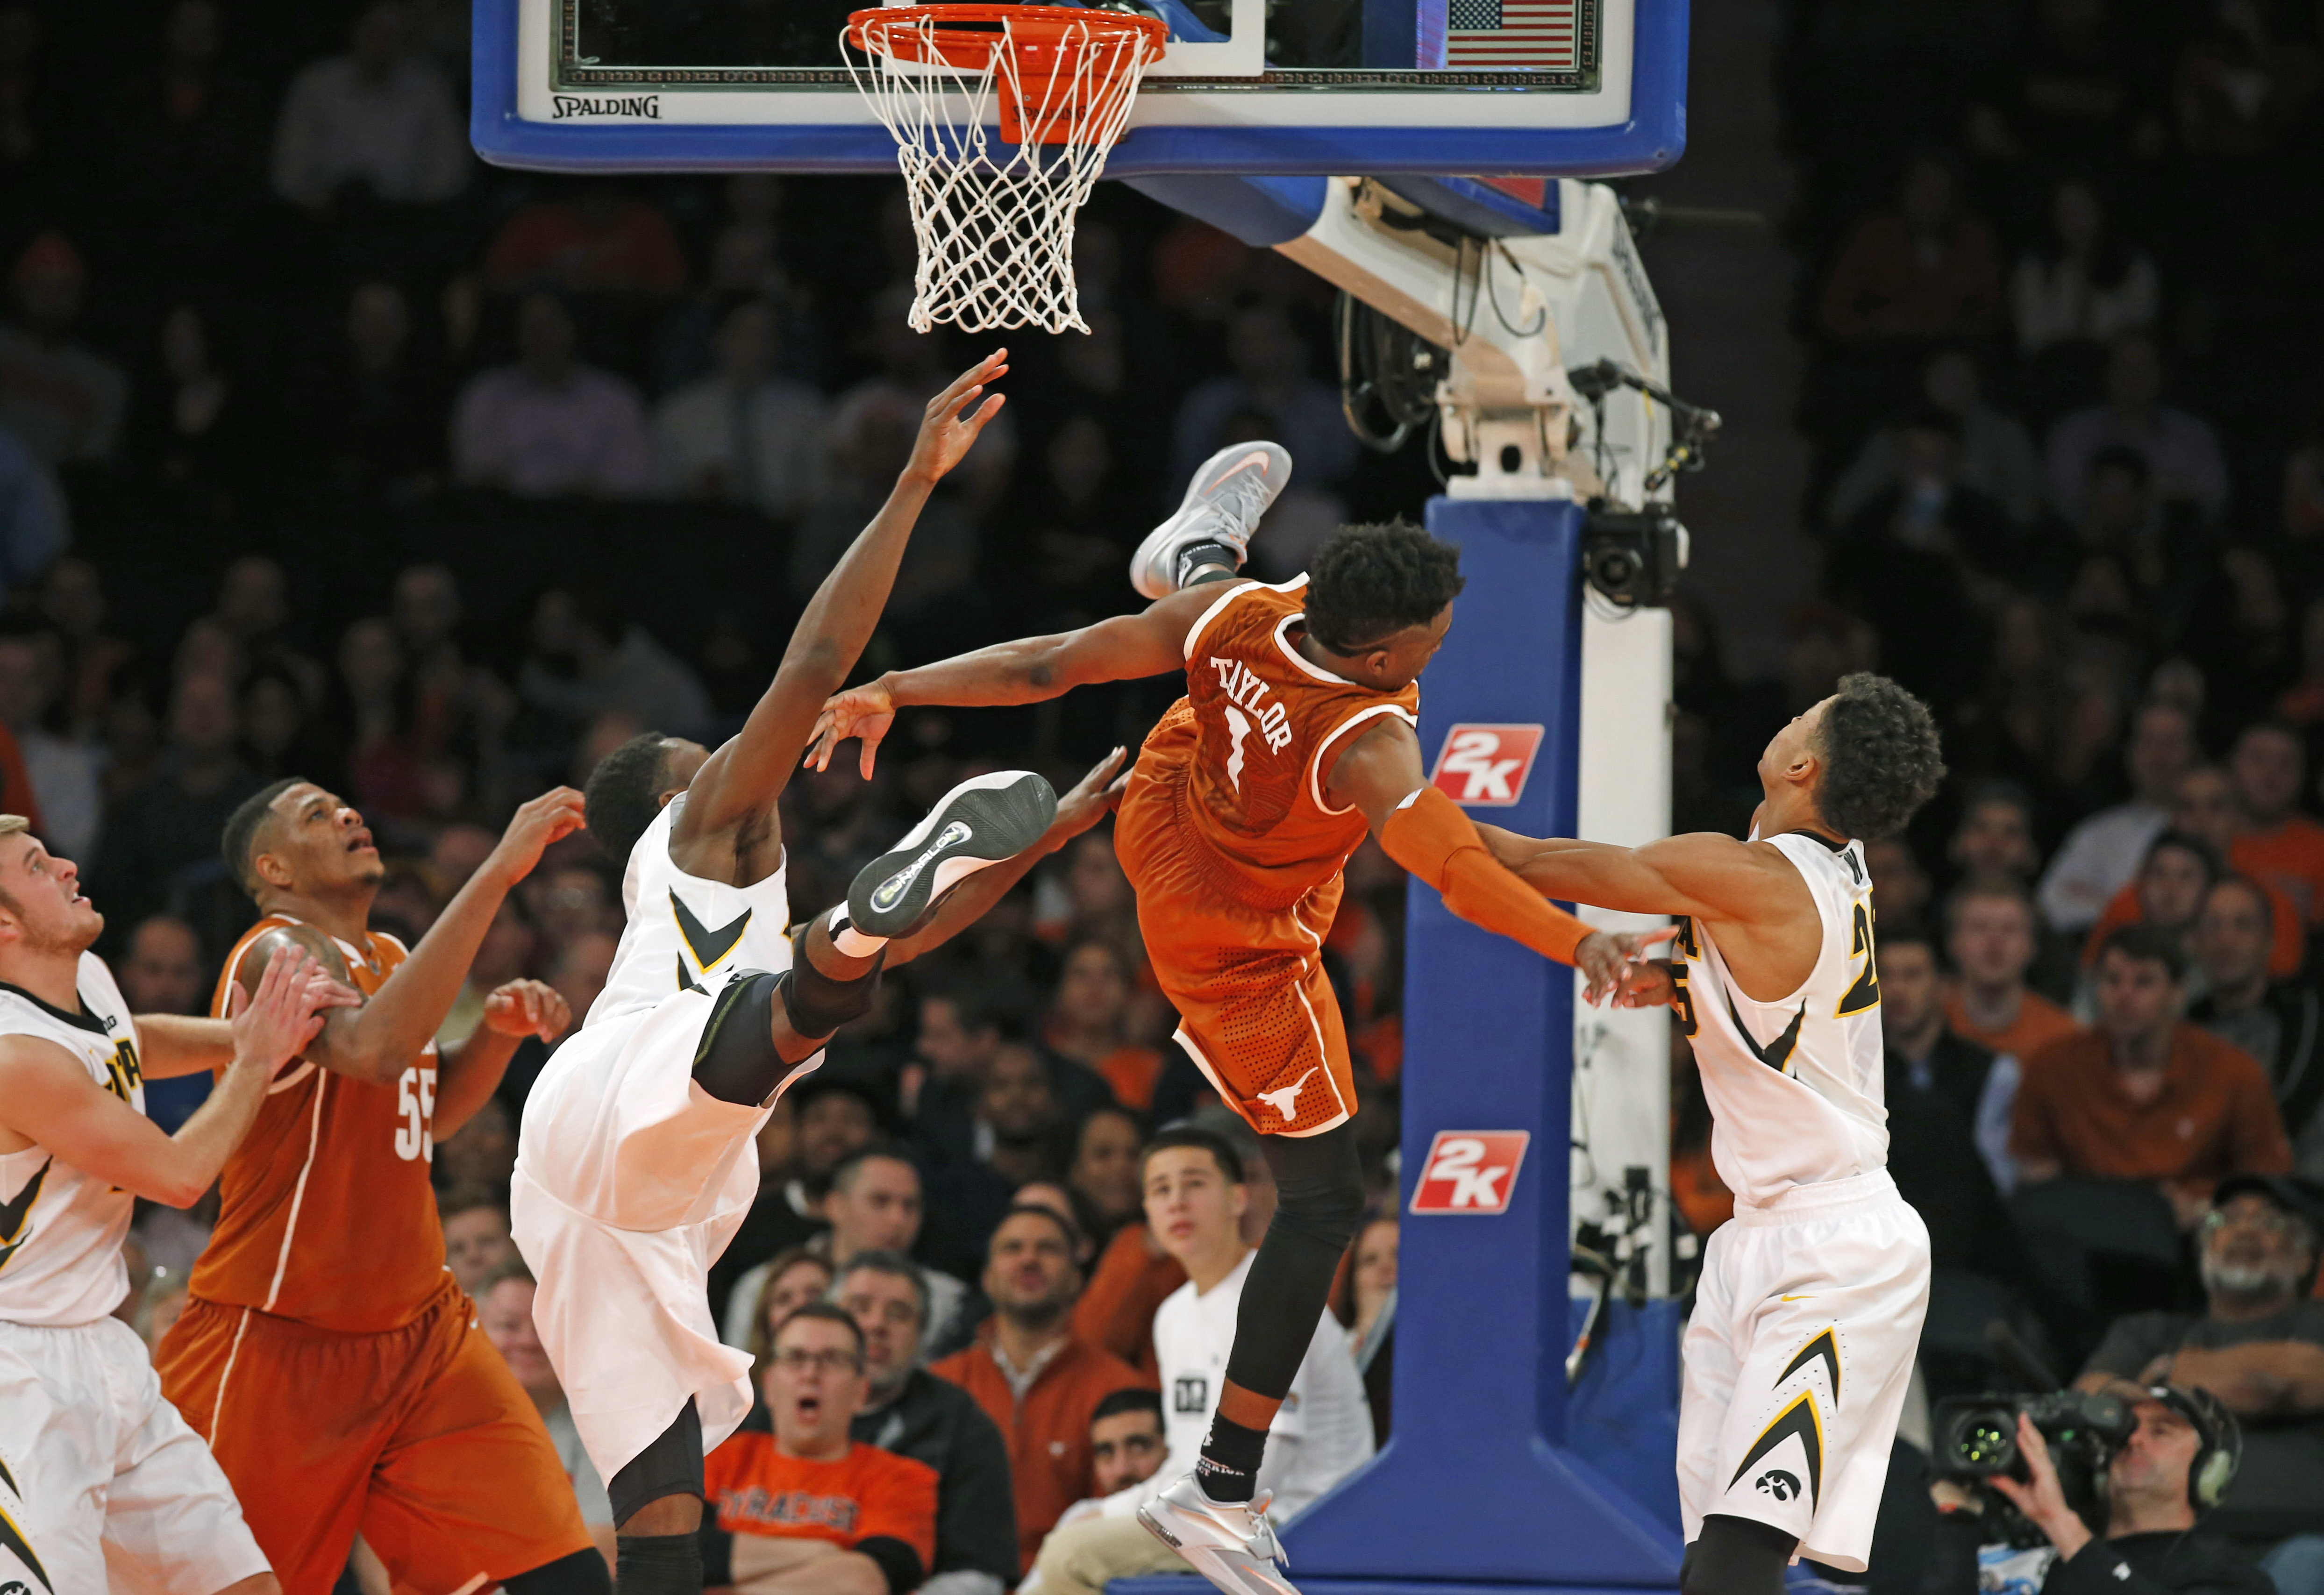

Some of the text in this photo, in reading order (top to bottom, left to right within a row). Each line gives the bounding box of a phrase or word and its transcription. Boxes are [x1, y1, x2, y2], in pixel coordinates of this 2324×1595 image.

[553, 95, 660, 120] SPALDING
[1210, 656, 1293, 756] TAYLOR
[1224, 704, 1252, 795] 1
[1443, 732, 1521, 799] 2K
[1833, 886, 1882, 1019] 2
[394, 1066, 437, 1163] 55
[1429, 1139, 1509, 1207] 2K
